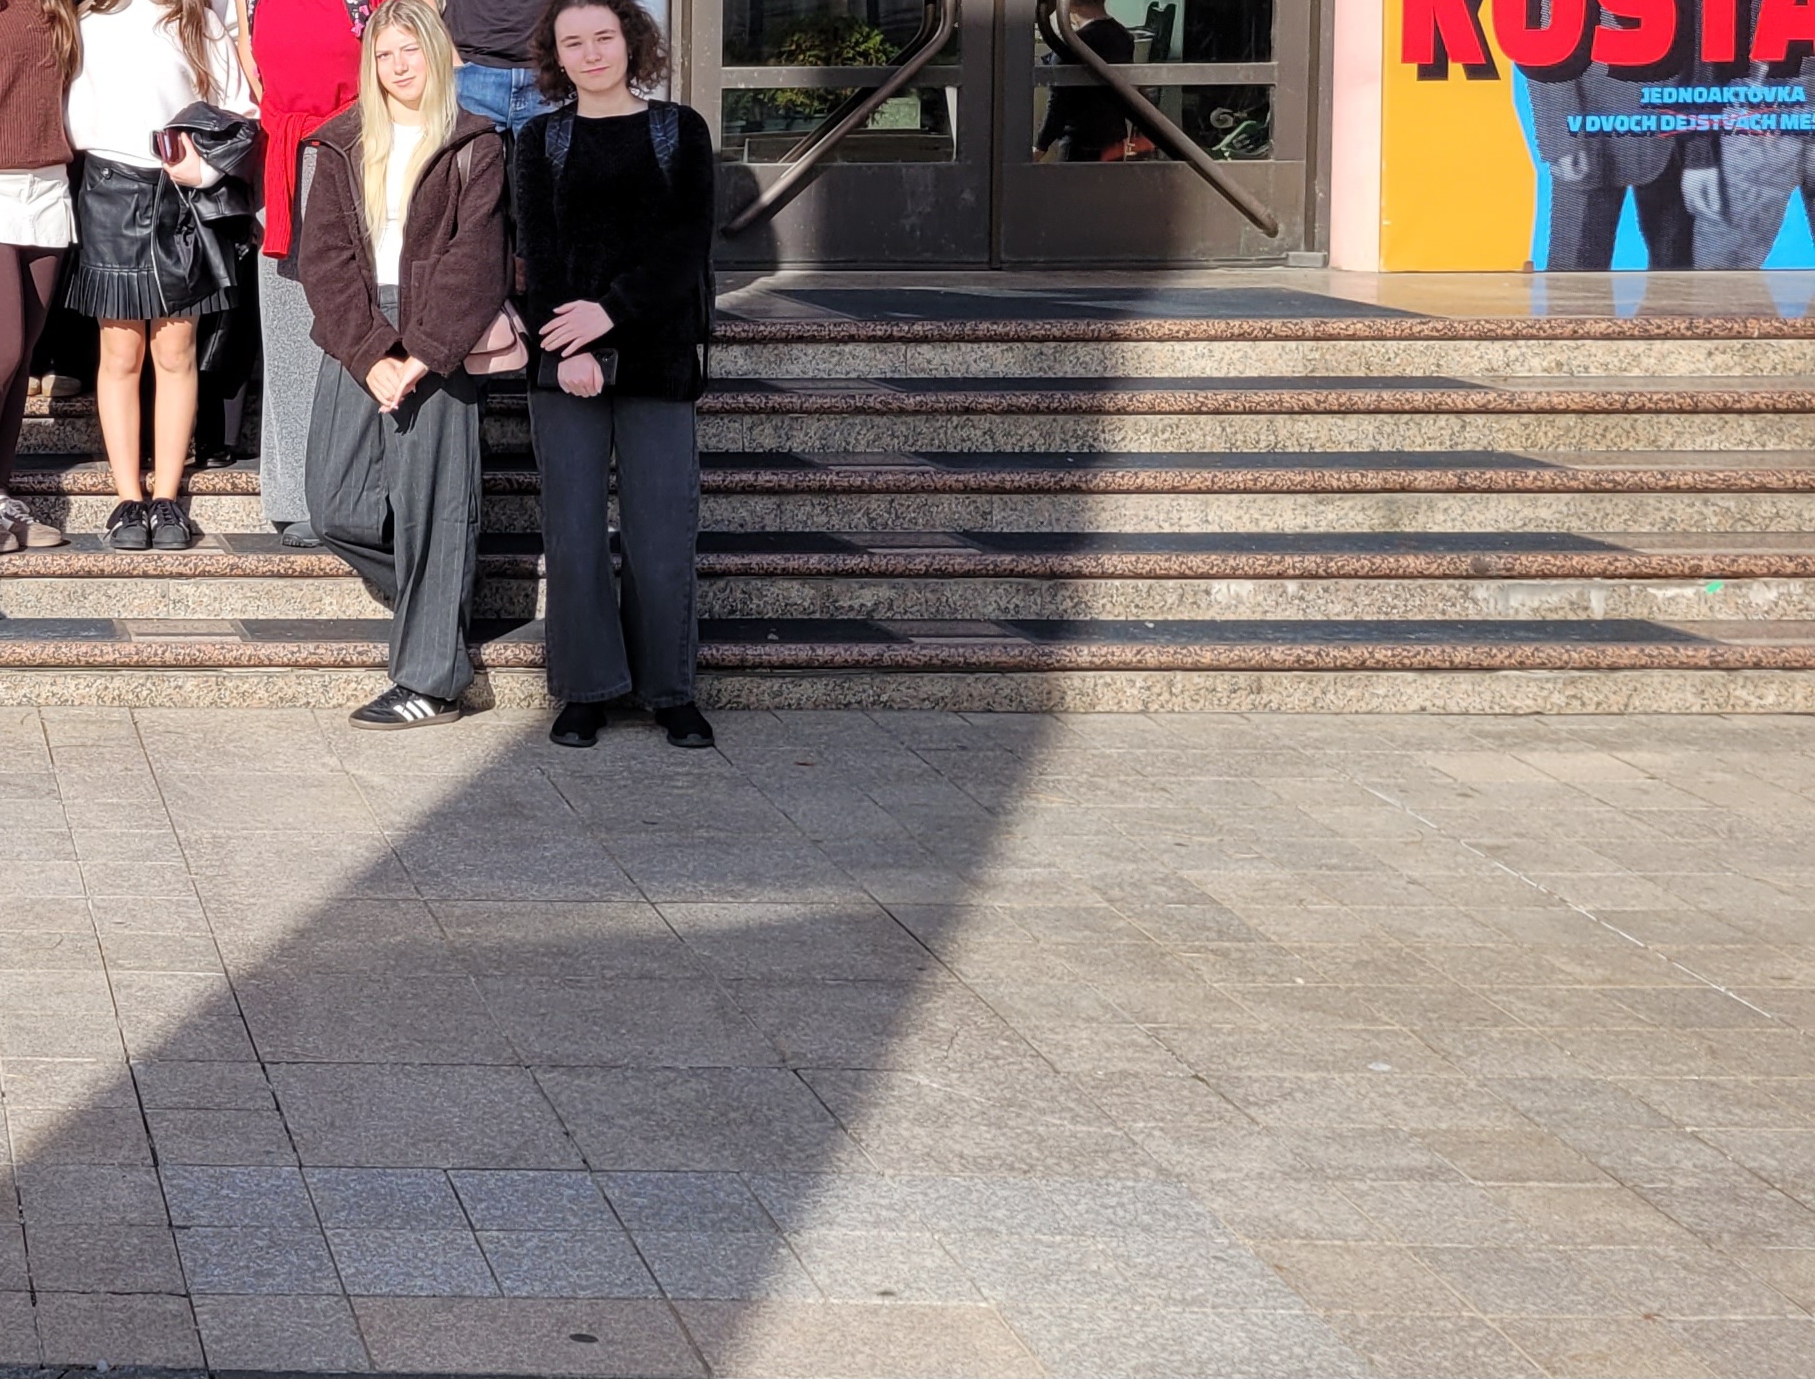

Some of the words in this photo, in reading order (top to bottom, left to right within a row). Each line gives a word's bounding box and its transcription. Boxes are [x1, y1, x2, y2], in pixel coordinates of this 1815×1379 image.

[1640, 86, 1805, 104] JEDNOAKTOVKA
[1567, 115, 1583, 132] V
[1585, 115, 1657, 132] DVOCH
